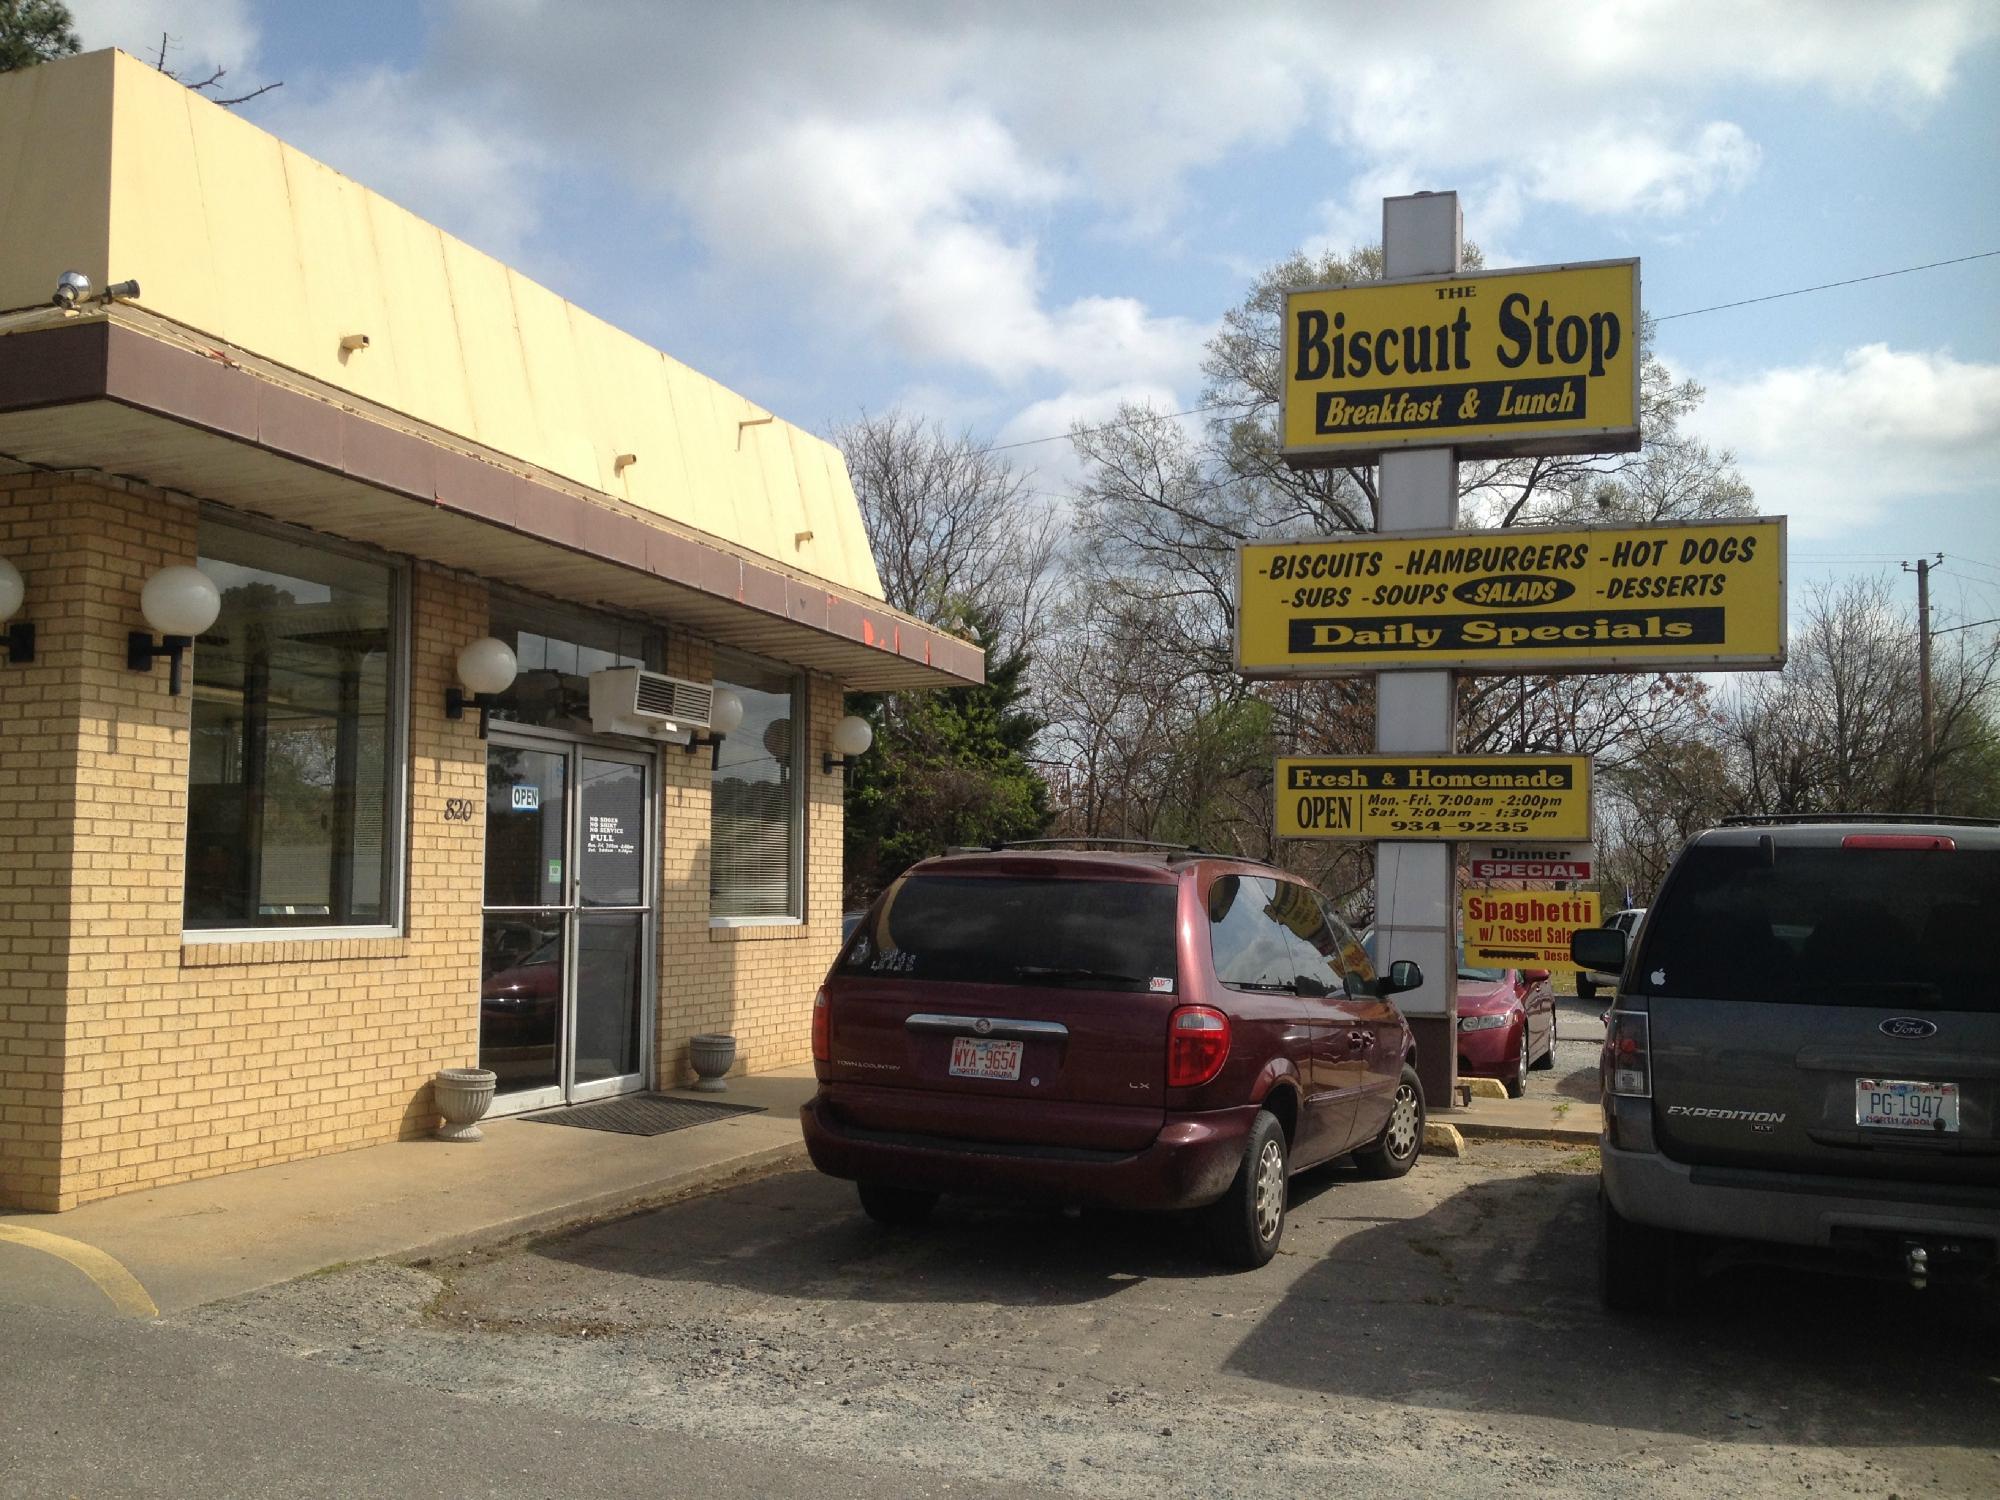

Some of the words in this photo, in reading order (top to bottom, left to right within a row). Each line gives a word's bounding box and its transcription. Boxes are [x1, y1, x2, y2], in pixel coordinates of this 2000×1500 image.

[1435, 286, 1477, 300] THE
[1294, 306, 1471, 381] Biscuit
[1496, 292, 1621, 377] Stop
[1323, 391, 1442, 427] Breakfast
[1457, 387, 1479, 419] &
[1496, 381, 1576, 417] Lunch
[1258, 551, 1383, 581] -BISCUITS
[1394, 542, 1589, 577] -HAMBURGERS
[1599, 539, 1668, 568] -HOT
[1679, 535, 1758, 566] DOGS
[1280, 586, 1352, 609] -SUBS
[1361, 582, 1449, 607] -SOUPS
[1463, 579, 1558, 603] -SALADS
[1595, 573, 1726, 600] -DESSERTS
[1311, 621, 1445, 649] Daily
[1459, 614, 1694, 648] Specials
[1294, 768, 1369, 788] Fresh
[1381, 771, 1397, 786] &
[1407, 768, 1566, 788] Homemade
[513, 787, 538, 806] OPEN
[444, 798, 473, 822] 820
[1296, 796, 1352, 830] OPEN
[1368, 807, 1399, 817] Sat.
[1410, 807, 1472, 817] 7:00am
[1495, 808, 1558, 820] 1:30pm
[1391, 820, 1529, 833] 934-9235
[590, 834, 615, 842] PULL
[1491, 847, 1571, 860] Dinner
[1479, 863, 1583, 878] SPECIAL
[1468, 896, 1591, 924] Spaghetti
[1479, 925, 1494, 942] w/
[1499, 925, 1543, 943] Tossed
[1546, 926, 1573, 944] Sala
[954, 1047, 1017, 1071] WYA-9654
[1129, 1082, 1150, 1090] LX
[1667, 1104, 1786, 1124] EXPEDITION
[1871, 1092, 1943, 1119] PG-1947
